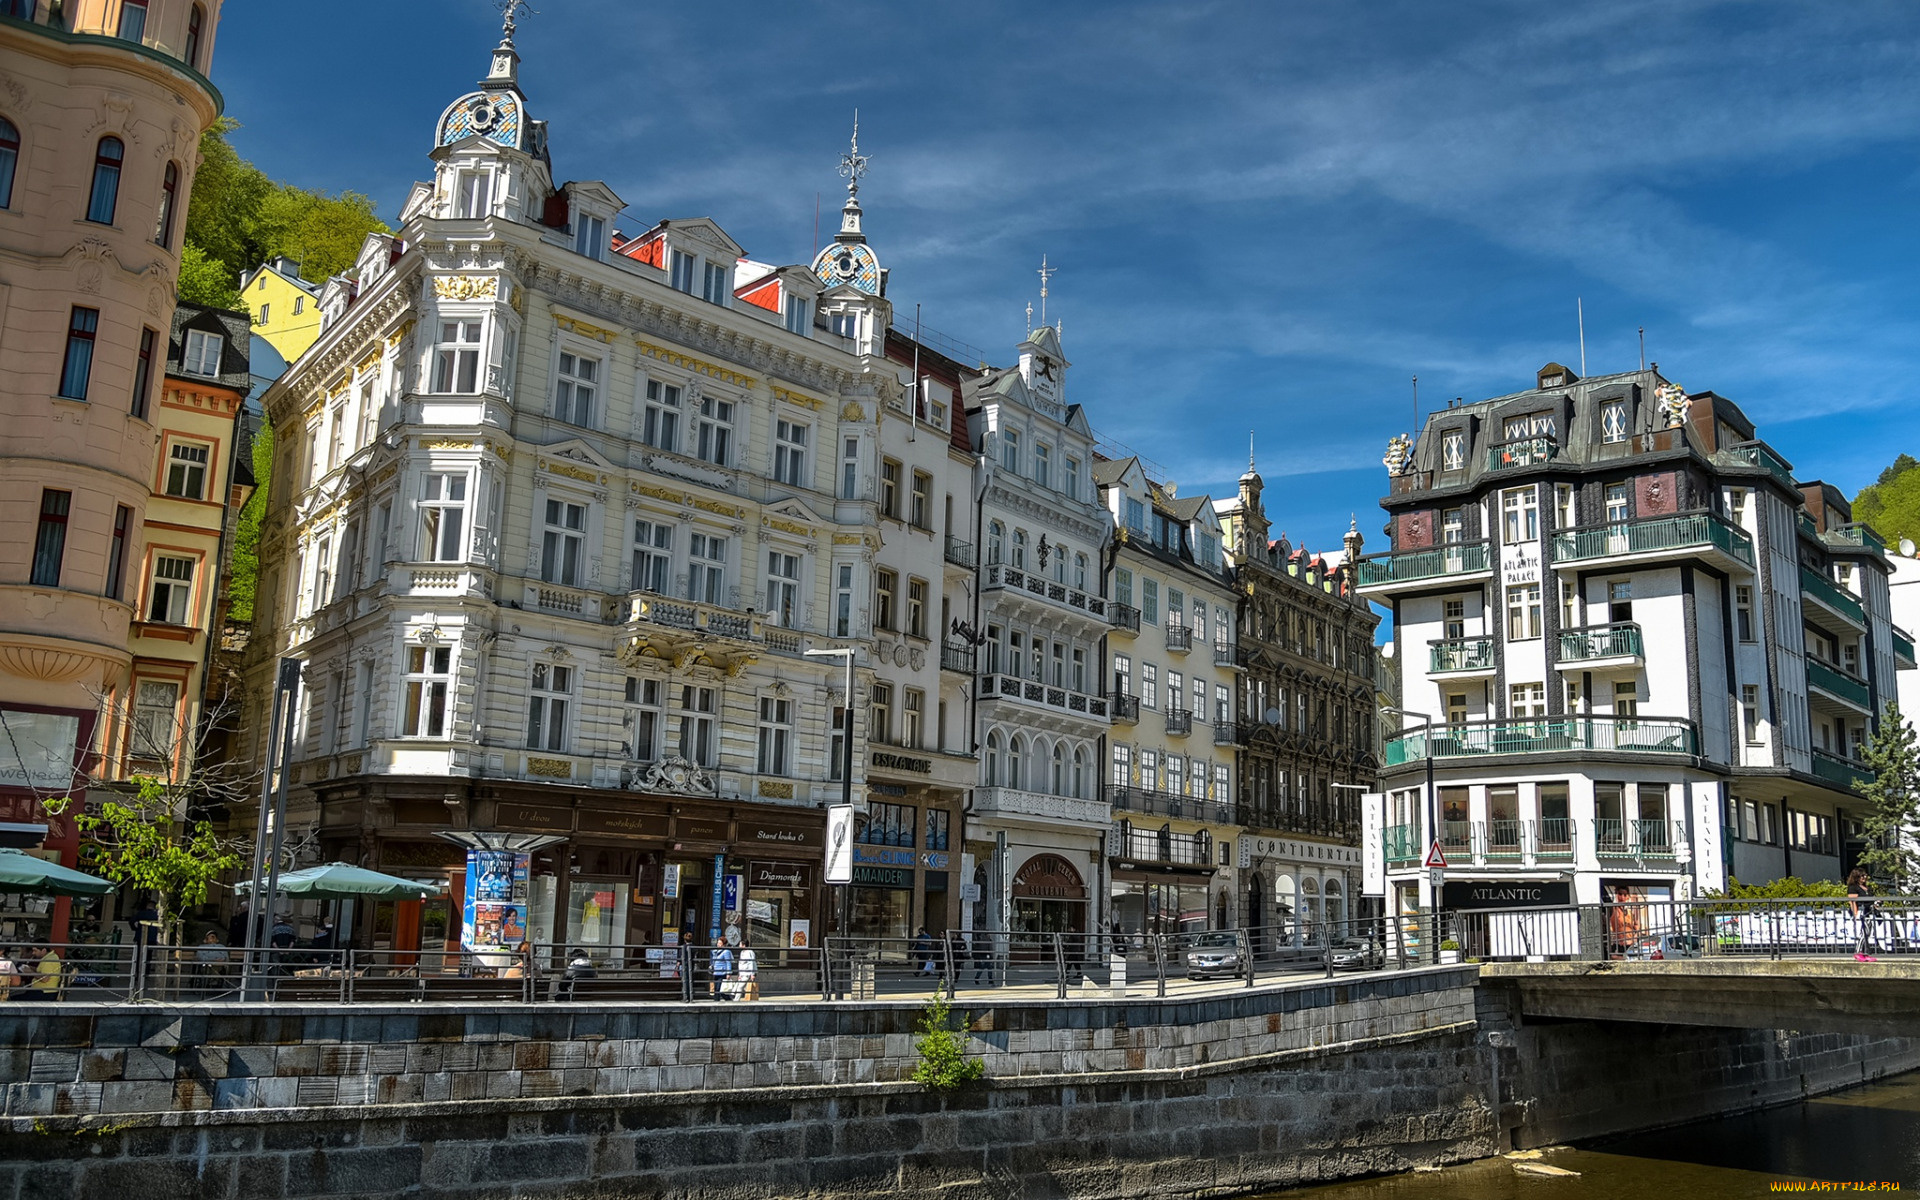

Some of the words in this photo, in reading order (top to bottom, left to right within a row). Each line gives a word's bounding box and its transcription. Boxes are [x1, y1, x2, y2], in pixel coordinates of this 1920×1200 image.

[1504, 557, 1538, 570] ATLANTIC
[1507, 570, 1535, 582] PALACE
[872, 752, 932, 773] ESPLANADE
[518, 811, 529, 821] U
[530, 812, 551, 823] dvou
[690, 826, 714, 835] panen
[778, 830, 796, 842] louka
[797, 832, 805, 842] 6
[1369, 803, 1377, 879] ATLANTIC
[1702, 793, 1713, 880] ATLANTIC
[880, 850, 916, 866] CLINIC
[1257, 839, 1361, 863] CONTINENTAL
[759, 870, 802, 882] Diamonds
[853, 867, 903, 884] AMANDER
[1020, 861, 1041, 882] ROYAL
[1057, 862, 1077, 885] CZECH
[1030, 885, 1069, 897] SOUVENIR
[1470, 888, 1542, 901] ATLANTIC
